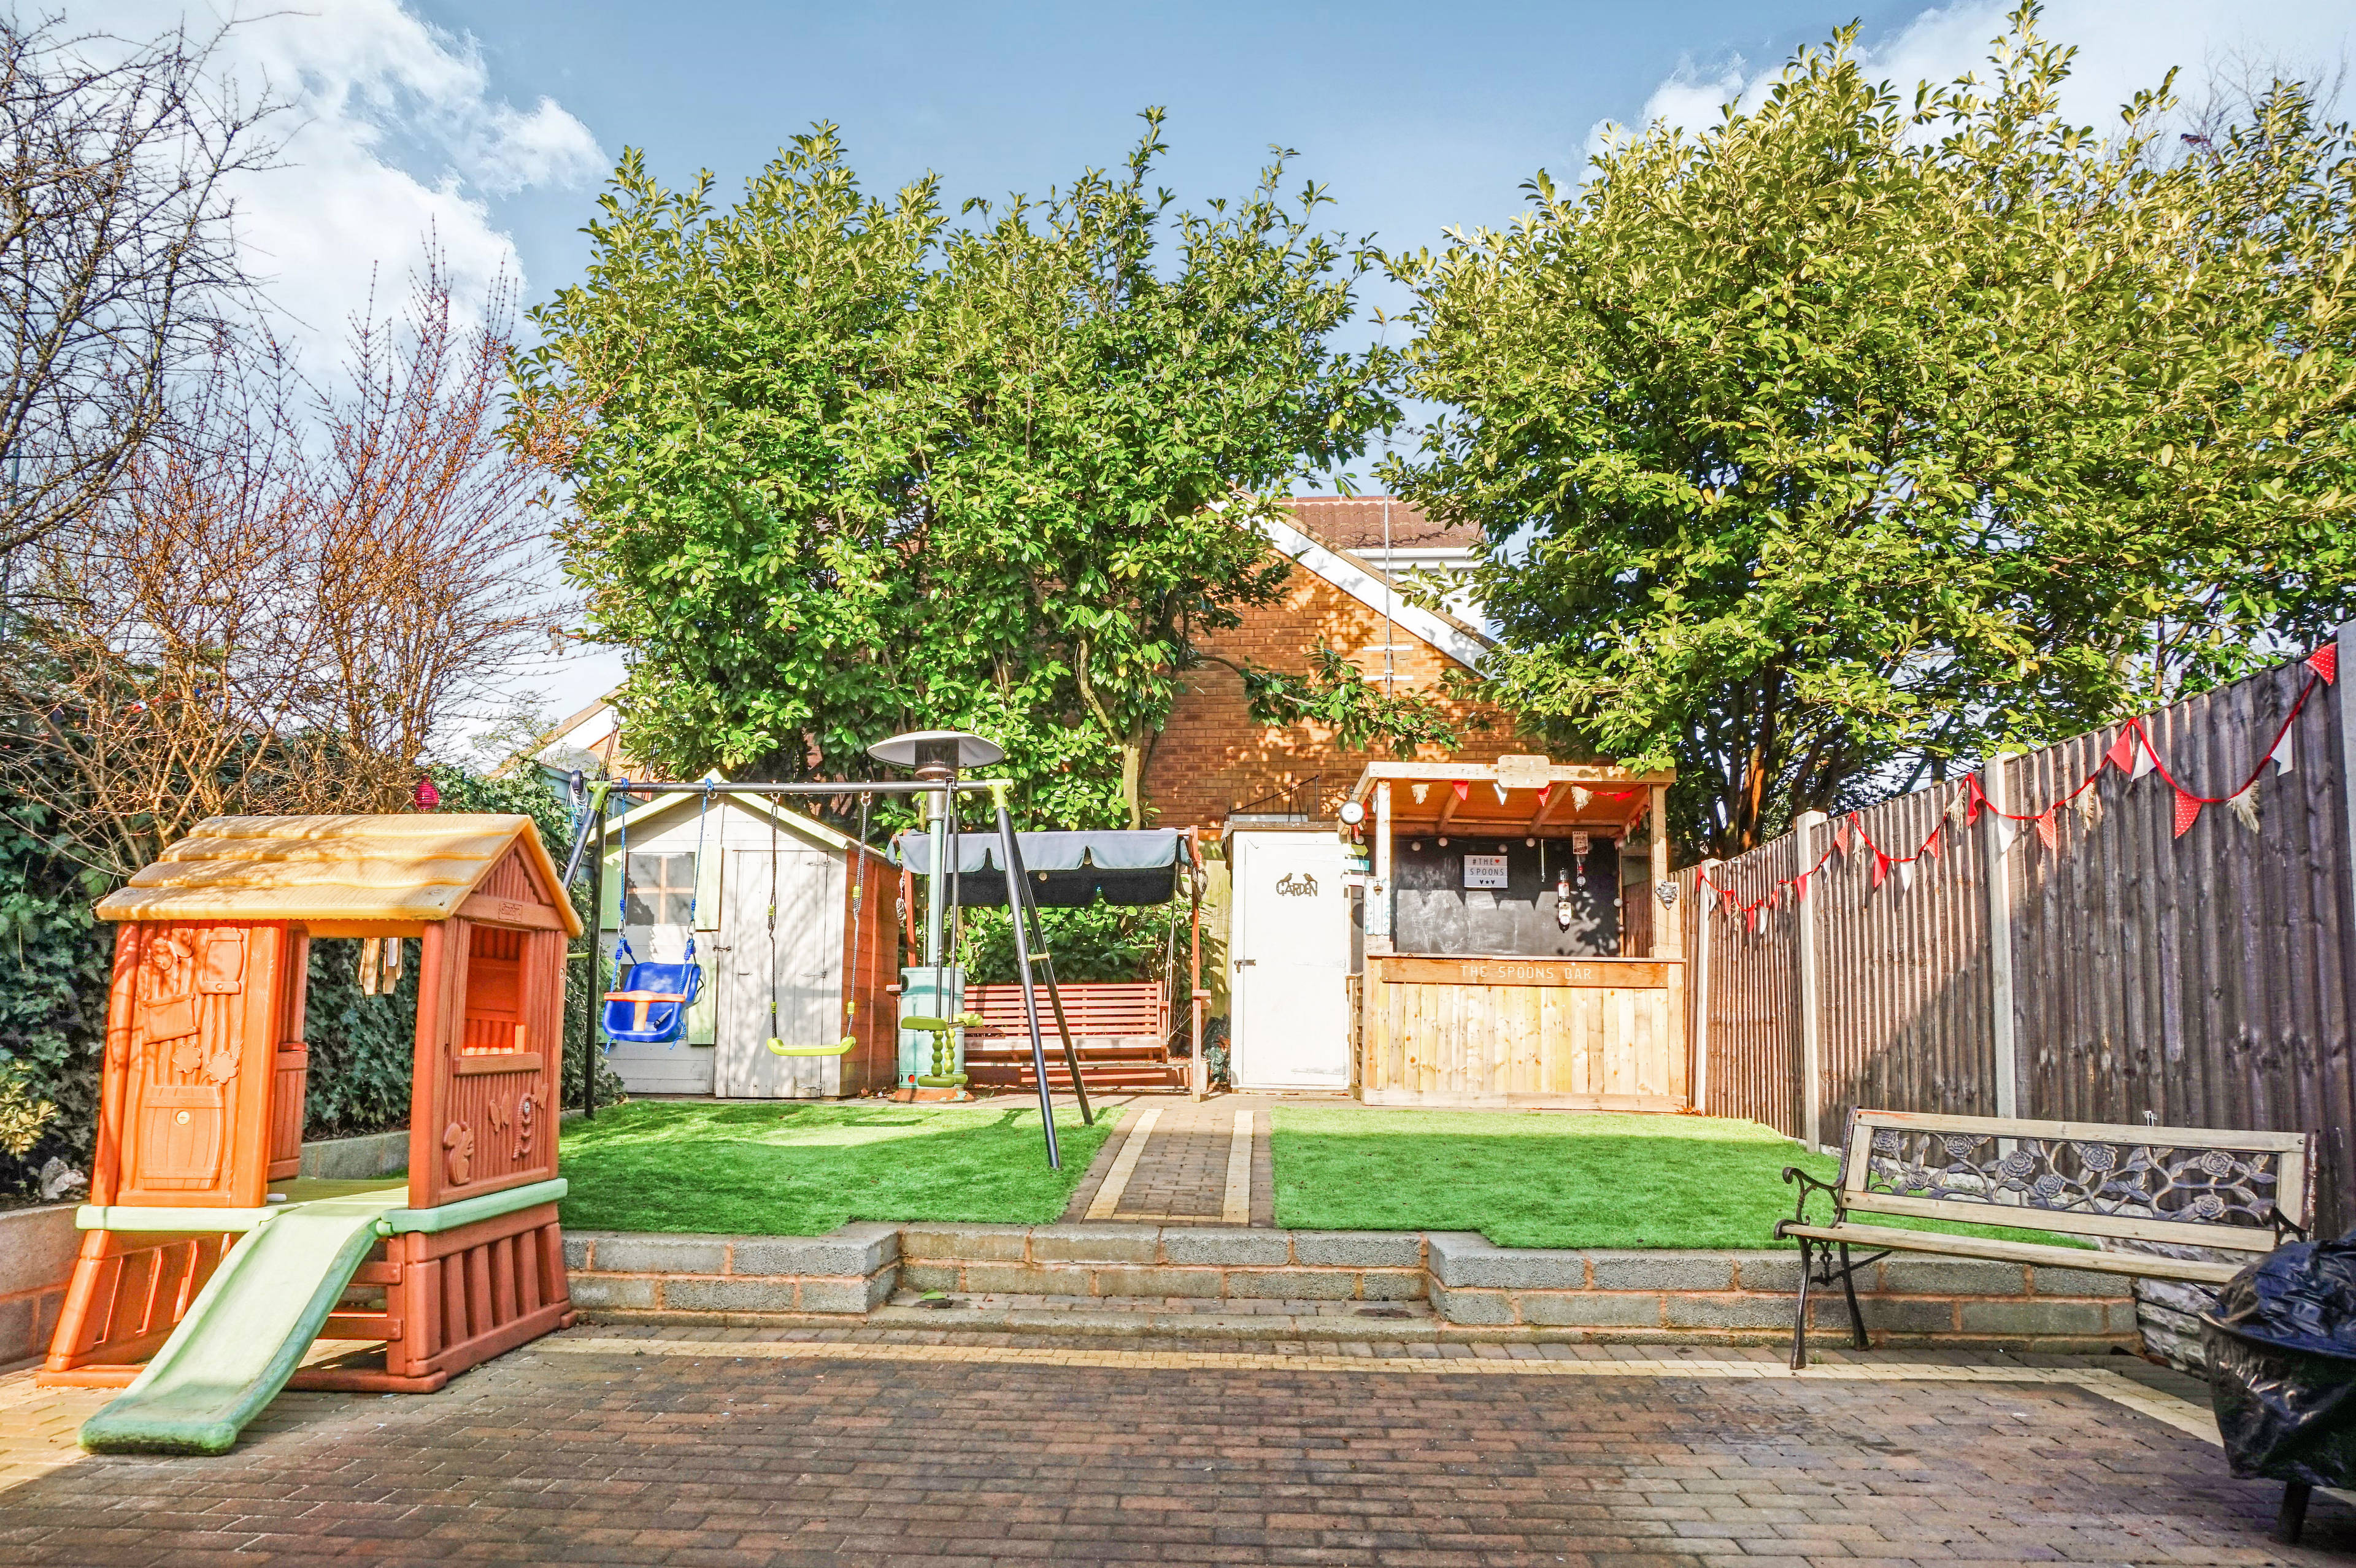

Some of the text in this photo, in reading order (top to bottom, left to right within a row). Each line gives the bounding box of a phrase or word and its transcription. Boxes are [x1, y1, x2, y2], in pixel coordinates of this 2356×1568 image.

[1276, 881, 1318, 896] GARDEN
[1460, 966, 1592, 980] THE SPOONS BAR
